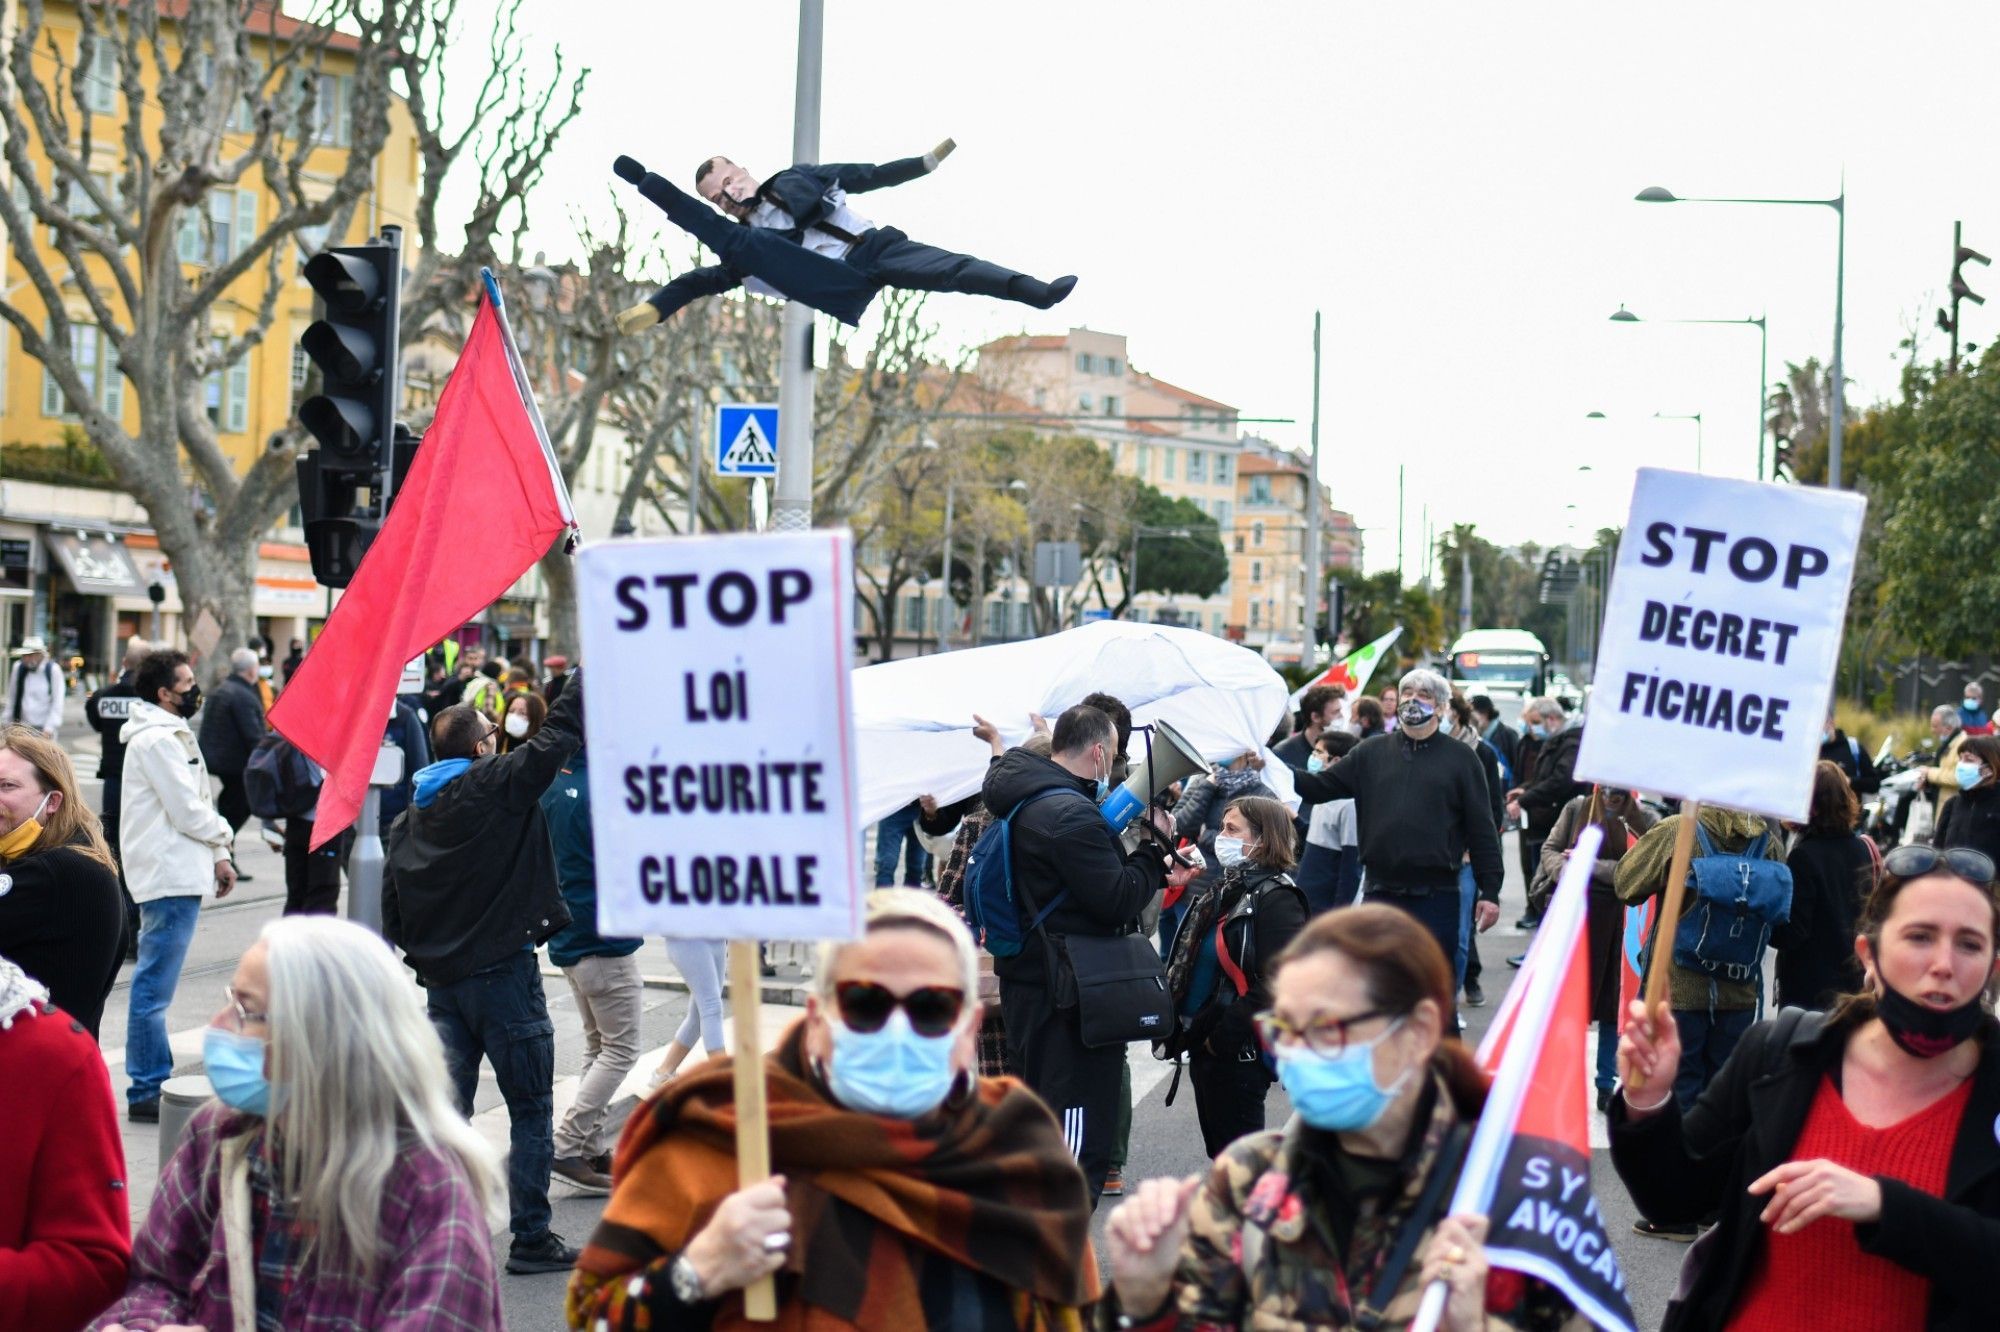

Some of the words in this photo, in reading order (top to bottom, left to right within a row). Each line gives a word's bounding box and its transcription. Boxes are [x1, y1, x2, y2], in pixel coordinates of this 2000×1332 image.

[1640, 521, 1830, 590] STOP
[614, 569, 813, 632] STOP
[1638, 591, 1799, 666] DÉCRET
[1619, 667, 1790, 742] FICHAGE
[623, 743, 827, 815] SÉCURITÉ
[639, 855, 821, 906] GLOBALE
